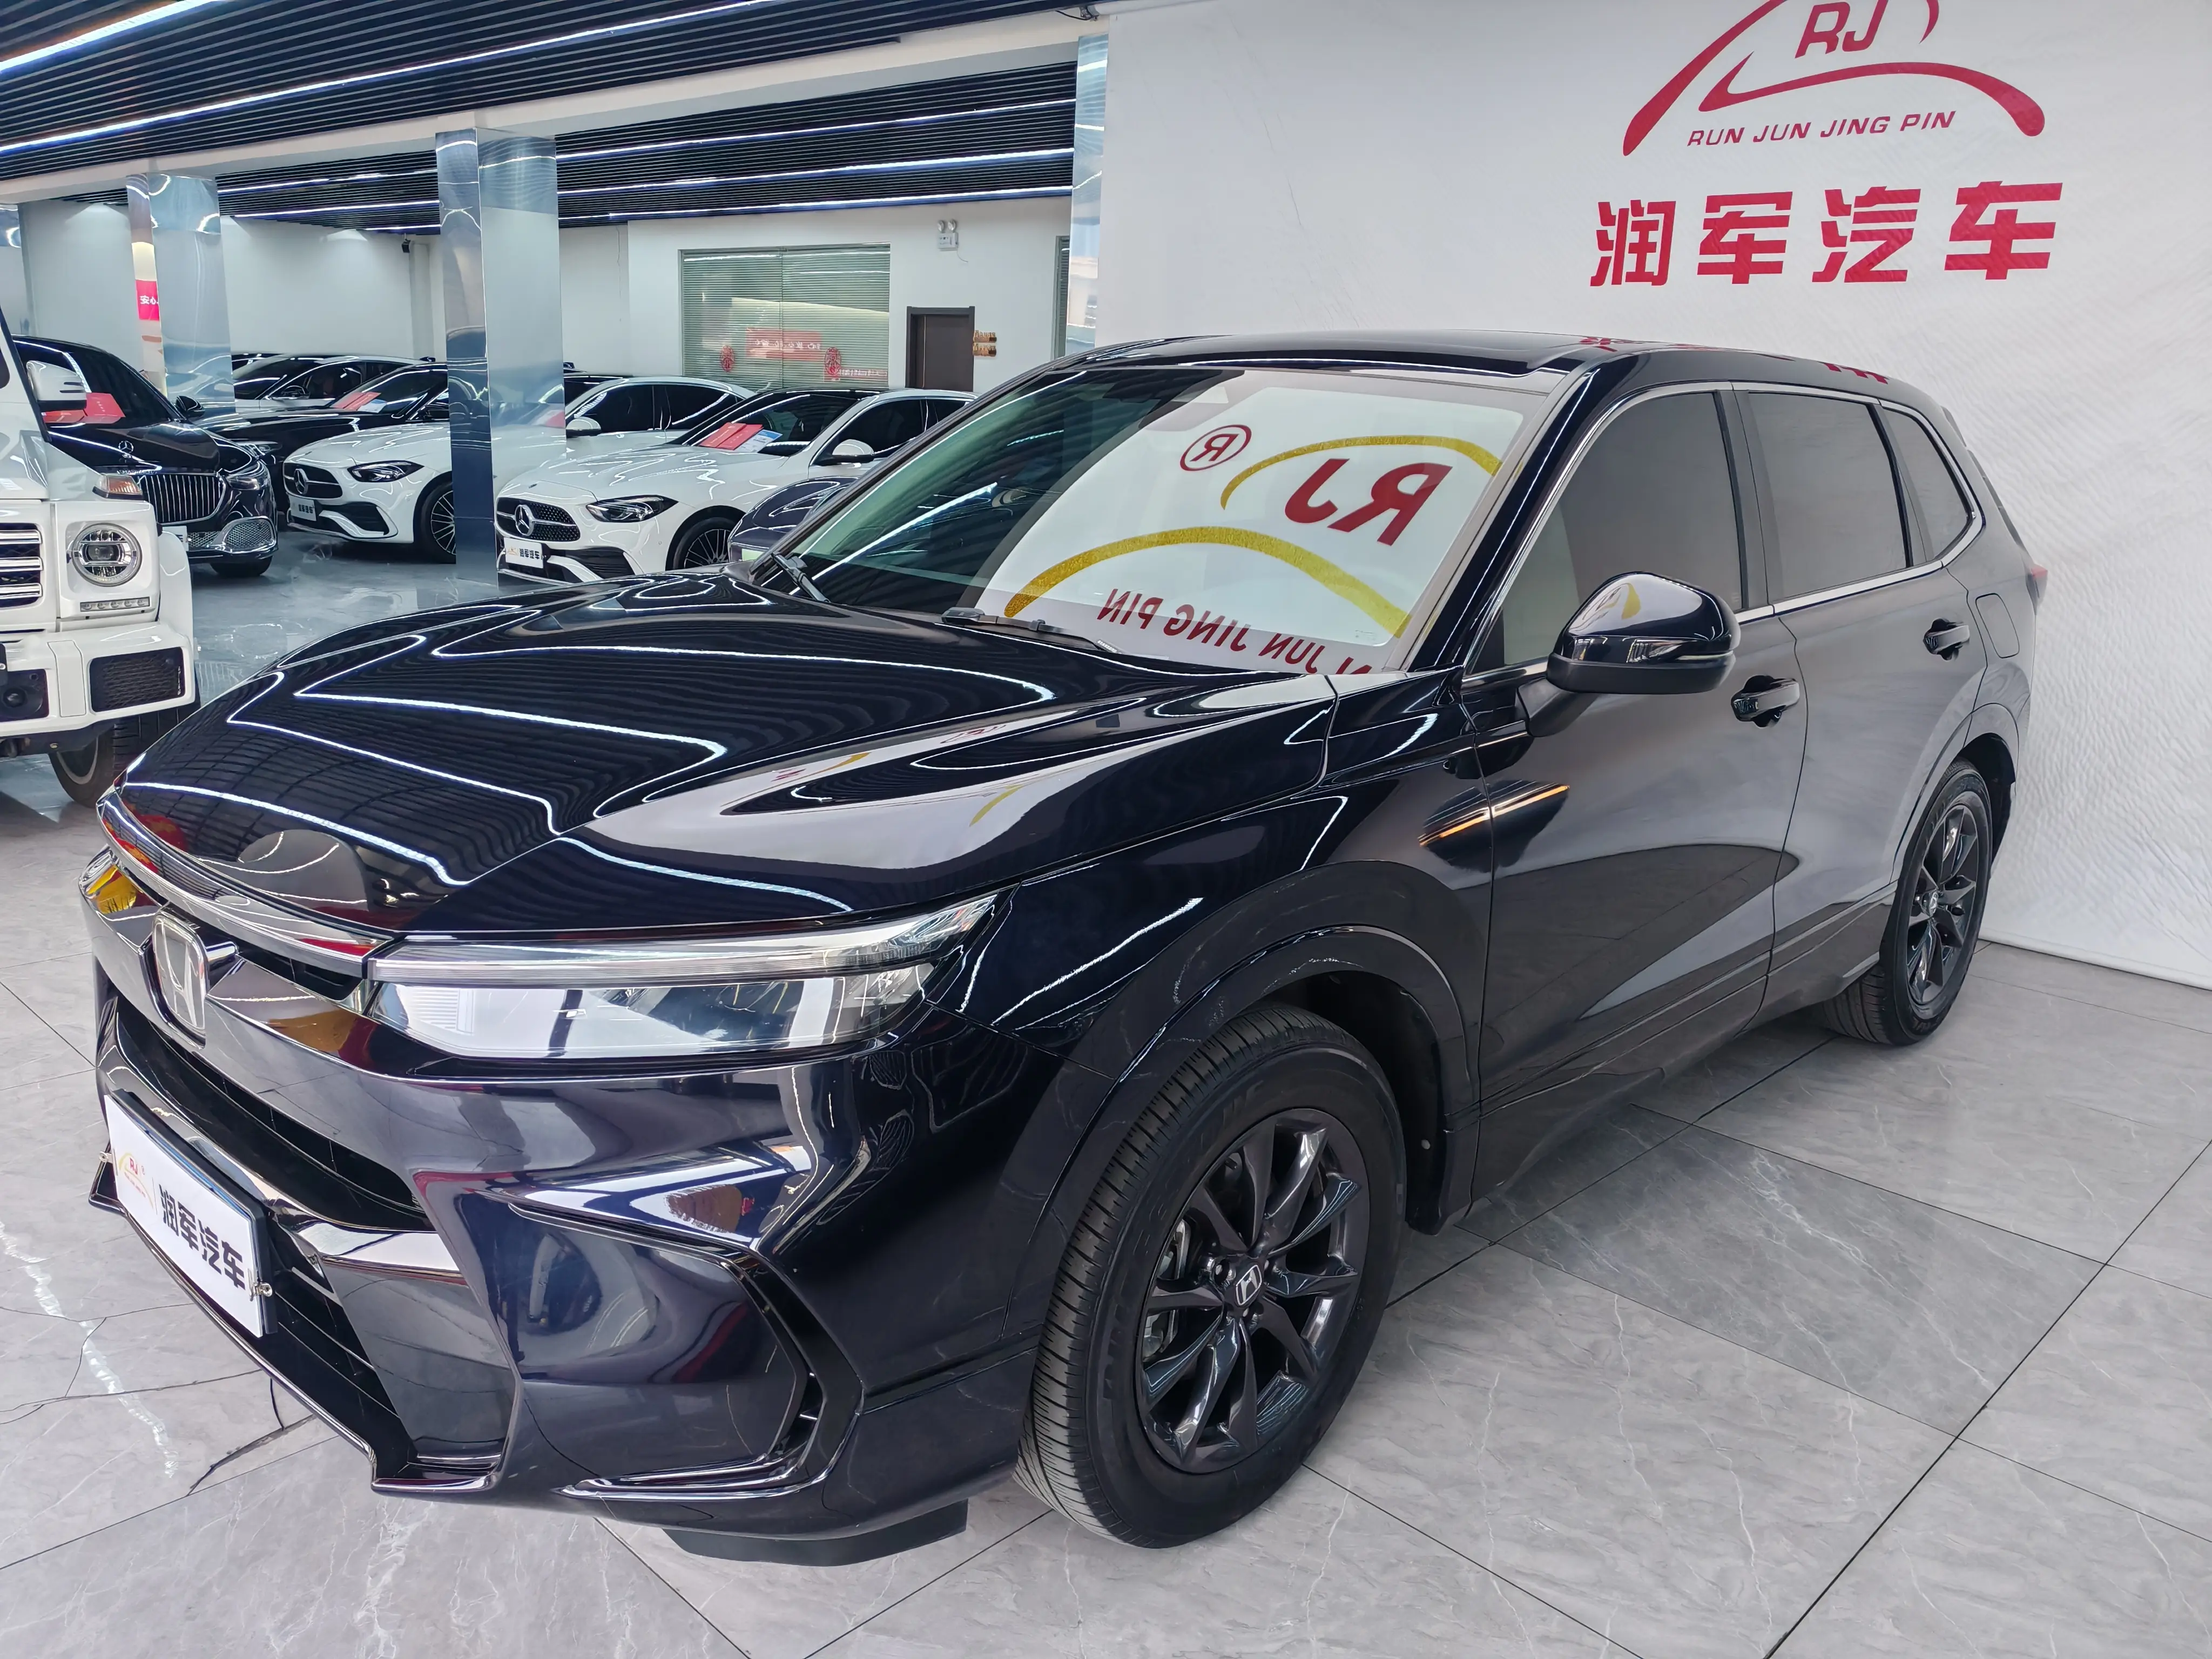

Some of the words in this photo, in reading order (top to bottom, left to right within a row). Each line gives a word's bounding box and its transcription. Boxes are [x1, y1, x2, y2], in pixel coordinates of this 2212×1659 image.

[1795, 0, 1889, 58] RJ
[1687, 127, 1745, 146] RUN
[1752, 122, 1812, 143] JUN
[1820, 116, 1891, 138] JING
[1899, 111, 1957, 134] PIN
[1590, 180, 2063, 287] 润军汽车
[159, 1184, 246, 1290] 润军汽车
